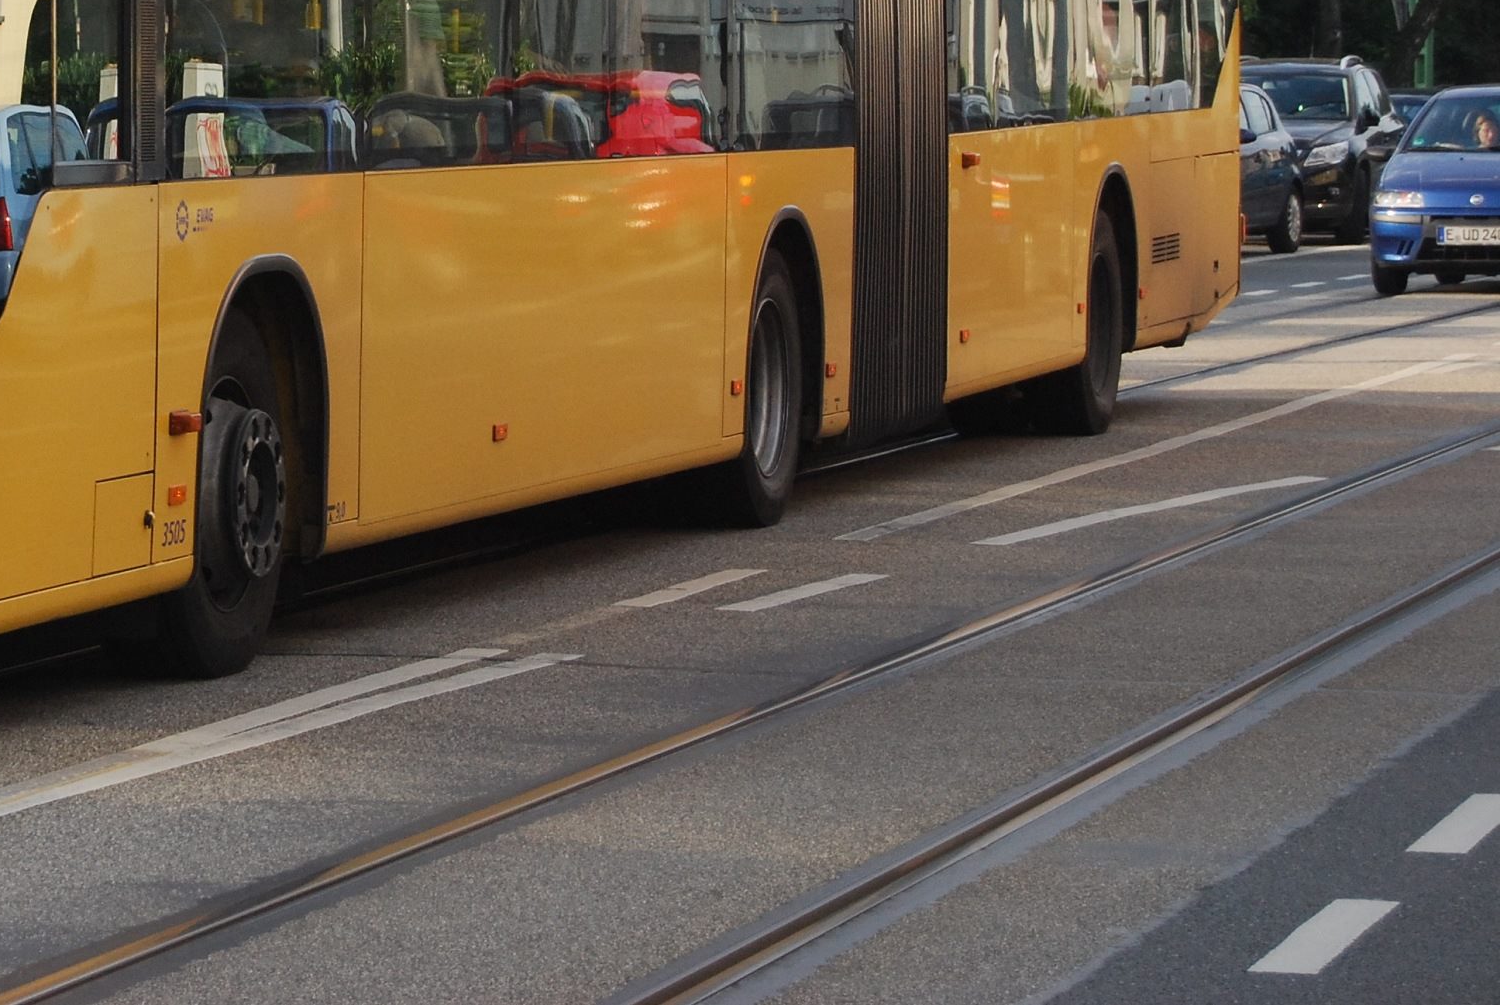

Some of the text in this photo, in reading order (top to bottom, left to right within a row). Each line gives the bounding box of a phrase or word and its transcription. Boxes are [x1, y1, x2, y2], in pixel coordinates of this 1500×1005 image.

[1445, 229, 1455, 241] E
[1462, 229, 1479, 241] UD
[161, 518, 187, 547] 3505
